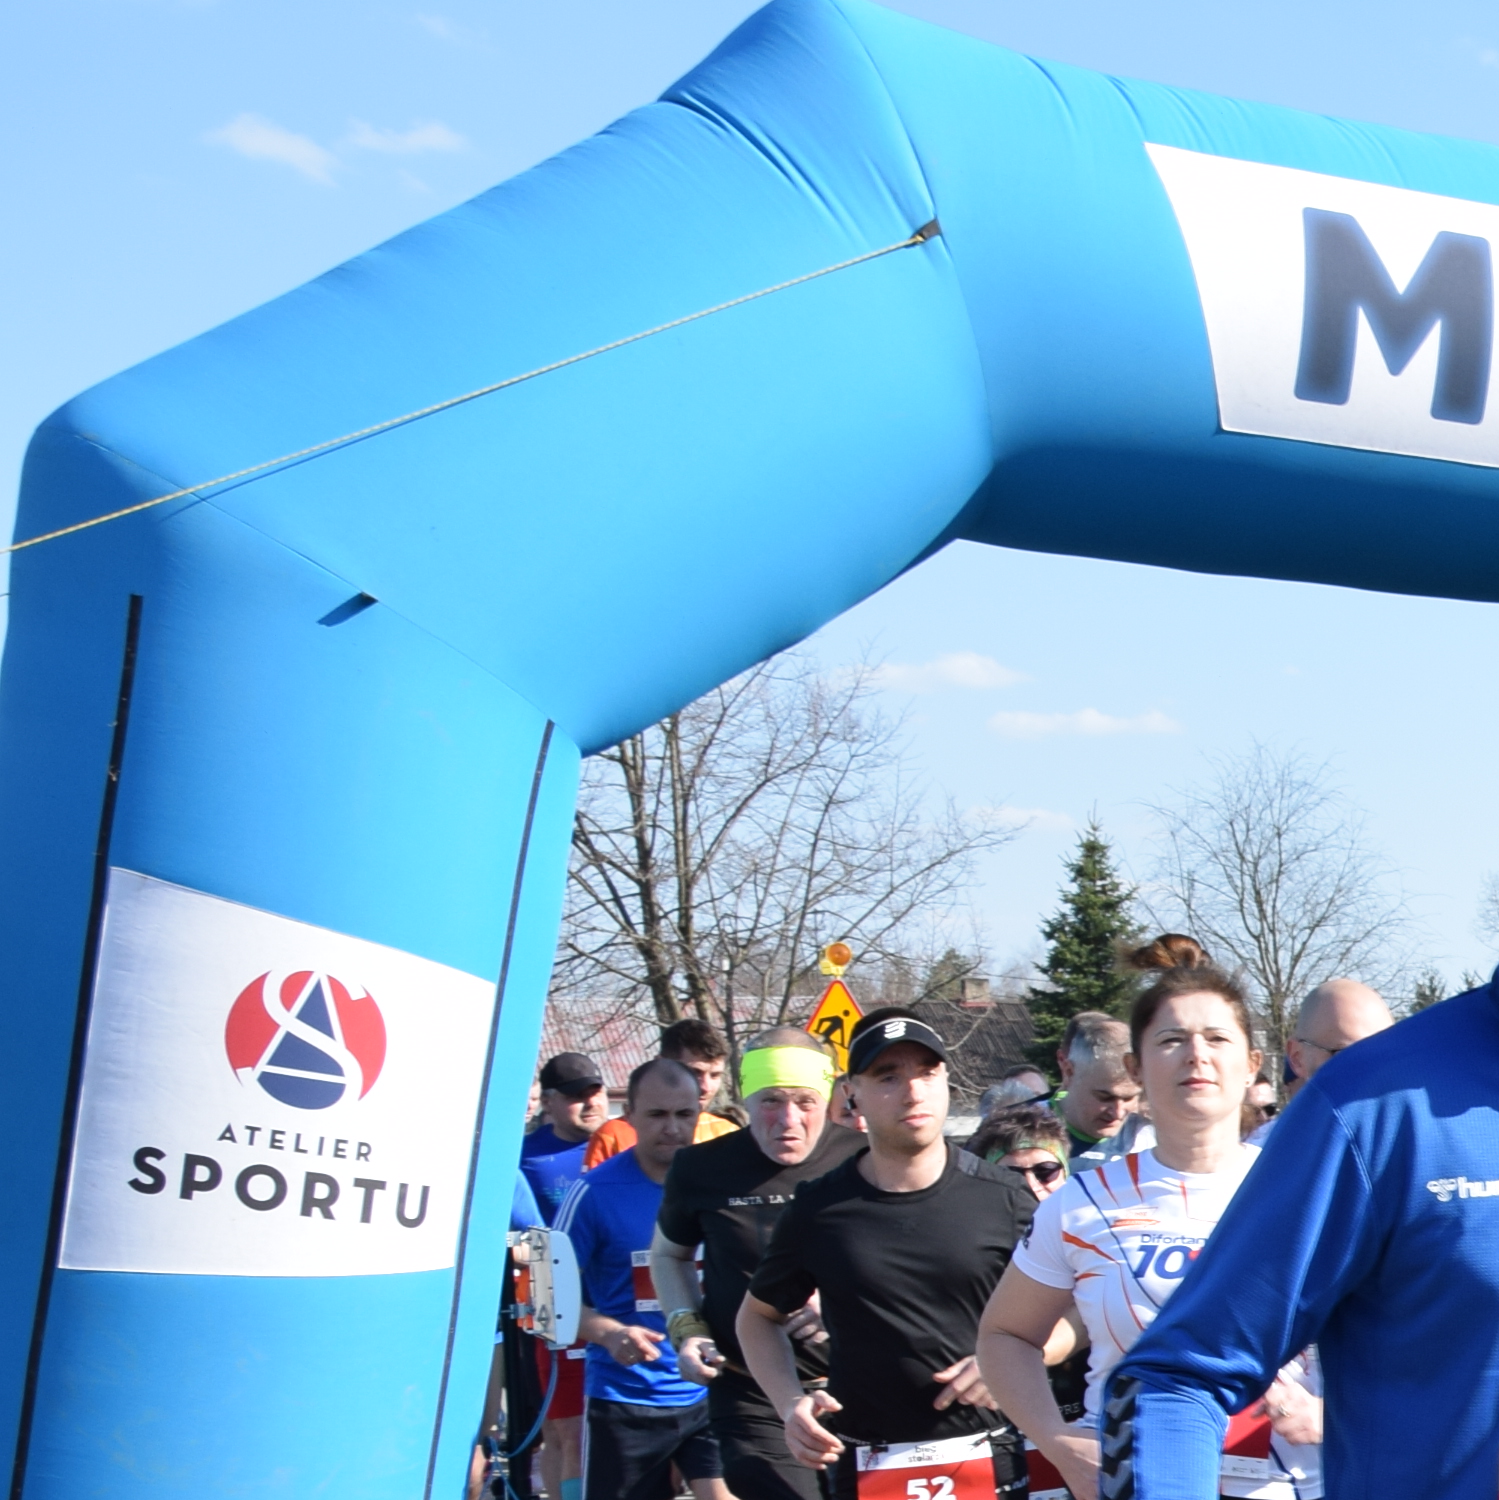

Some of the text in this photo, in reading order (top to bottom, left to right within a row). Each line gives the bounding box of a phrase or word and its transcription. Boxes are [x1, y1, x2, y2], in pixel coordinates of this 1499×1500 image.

[217, 1123, 373, 1162] ATELIER
[128, 1146, 431, 1229] SPORTU
[768, 1194, 786, 1204] LA
